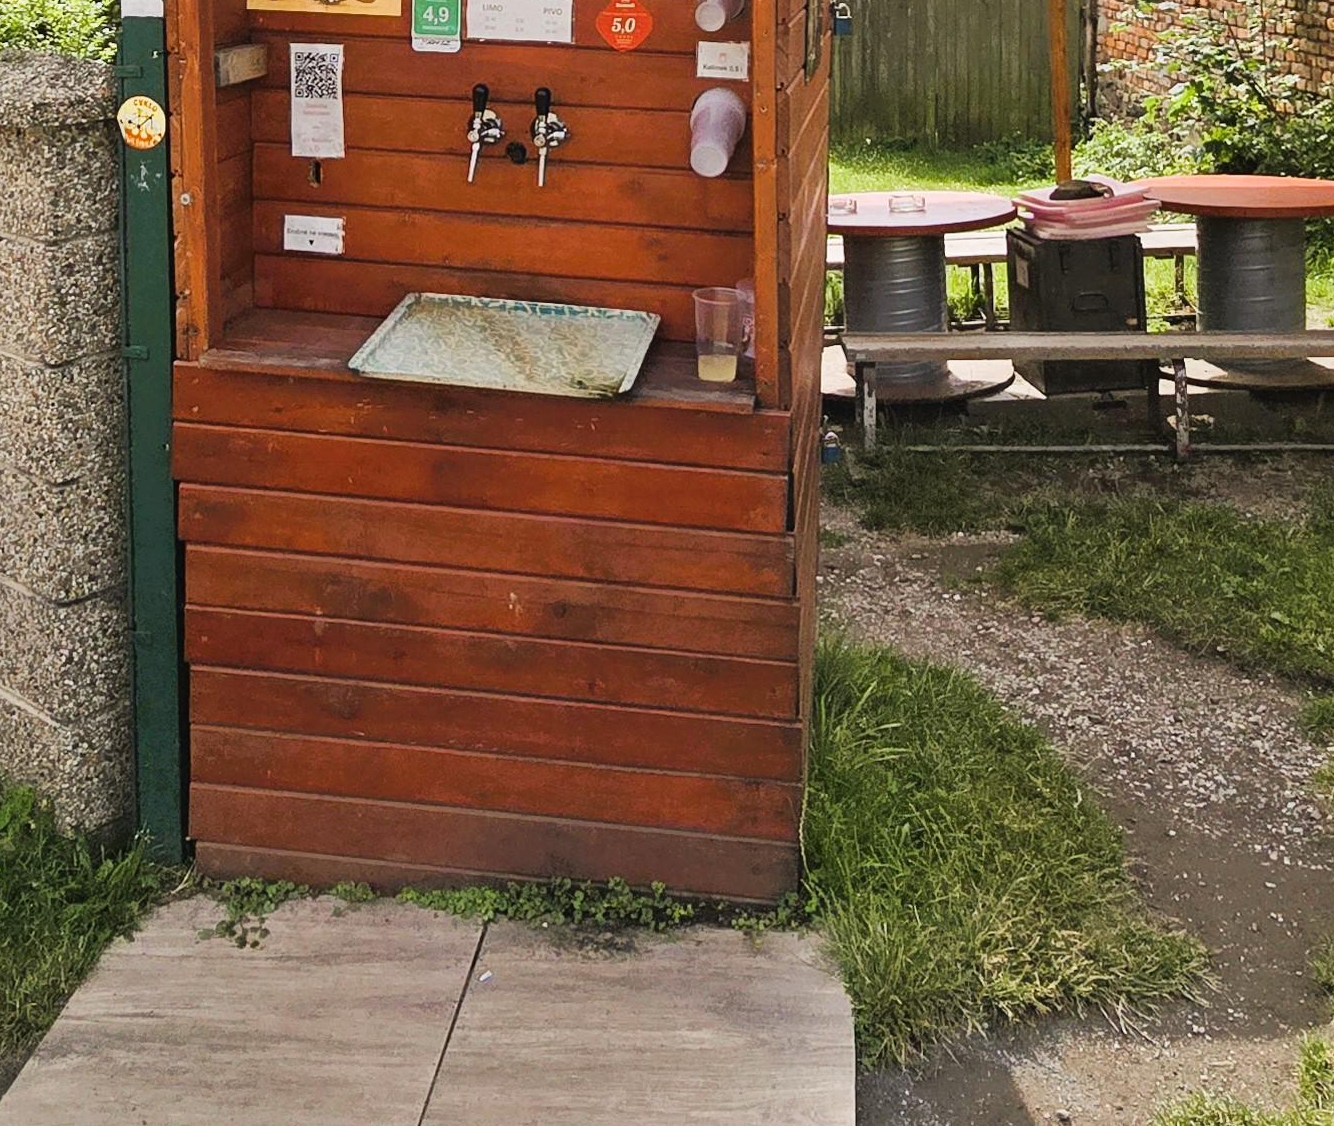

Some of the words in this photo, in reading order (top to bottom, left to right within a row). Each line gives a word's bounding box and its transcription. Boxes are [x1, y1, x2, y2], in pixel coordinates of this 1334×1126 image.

[422, 5, 450, 26] 4,9
[482, 4, 504, 13] LIMO
[542, 7, 564, 16] PIVO
[611, 17, 636, 34] 5,0
[133, 99, 158, 113] CYKLO
